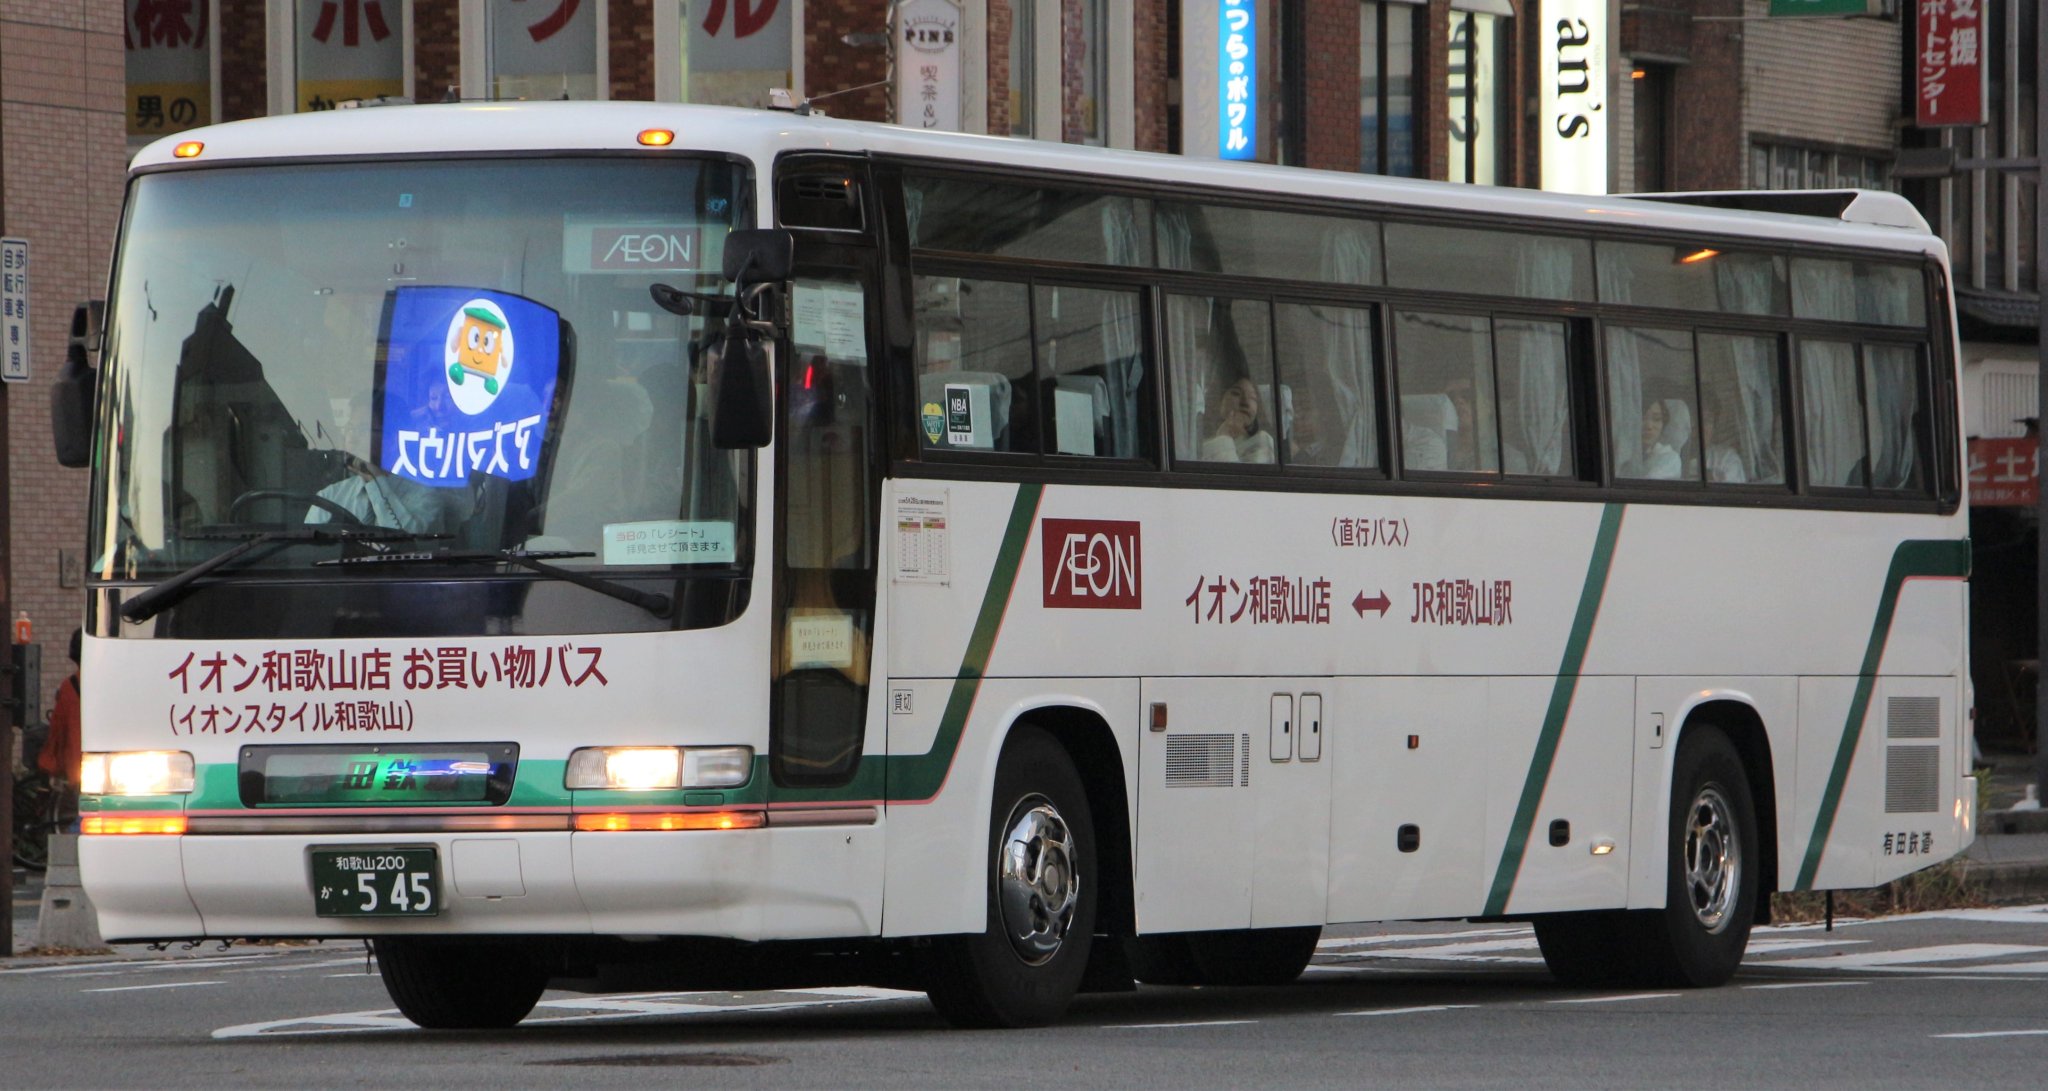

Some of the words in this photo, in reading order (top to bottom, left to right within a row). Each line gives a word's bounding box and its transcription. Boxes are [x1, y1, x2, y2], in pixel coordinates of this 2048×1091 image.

[1225, 0, 1250, 151] つらのポワル
[1556, 17, 1602, 139] an's
[135, 94, 198, 128] 男の
[1967, 446, 2040, 482] と土
[1185, 575, 1331, 625] イオン和歌山店
[1410, 578, 1513, 626] JR和歌山駅
[168, 647, 391, 694] イオン和歌山店
[402, 642, 609, 690] お買い物バス
[169, 699, 414, 736] (イオンスタイル和歌山)
[1882, 830, 1934, 856] 有田鉄道
[335, 855, 406, 872] 和歌山200
